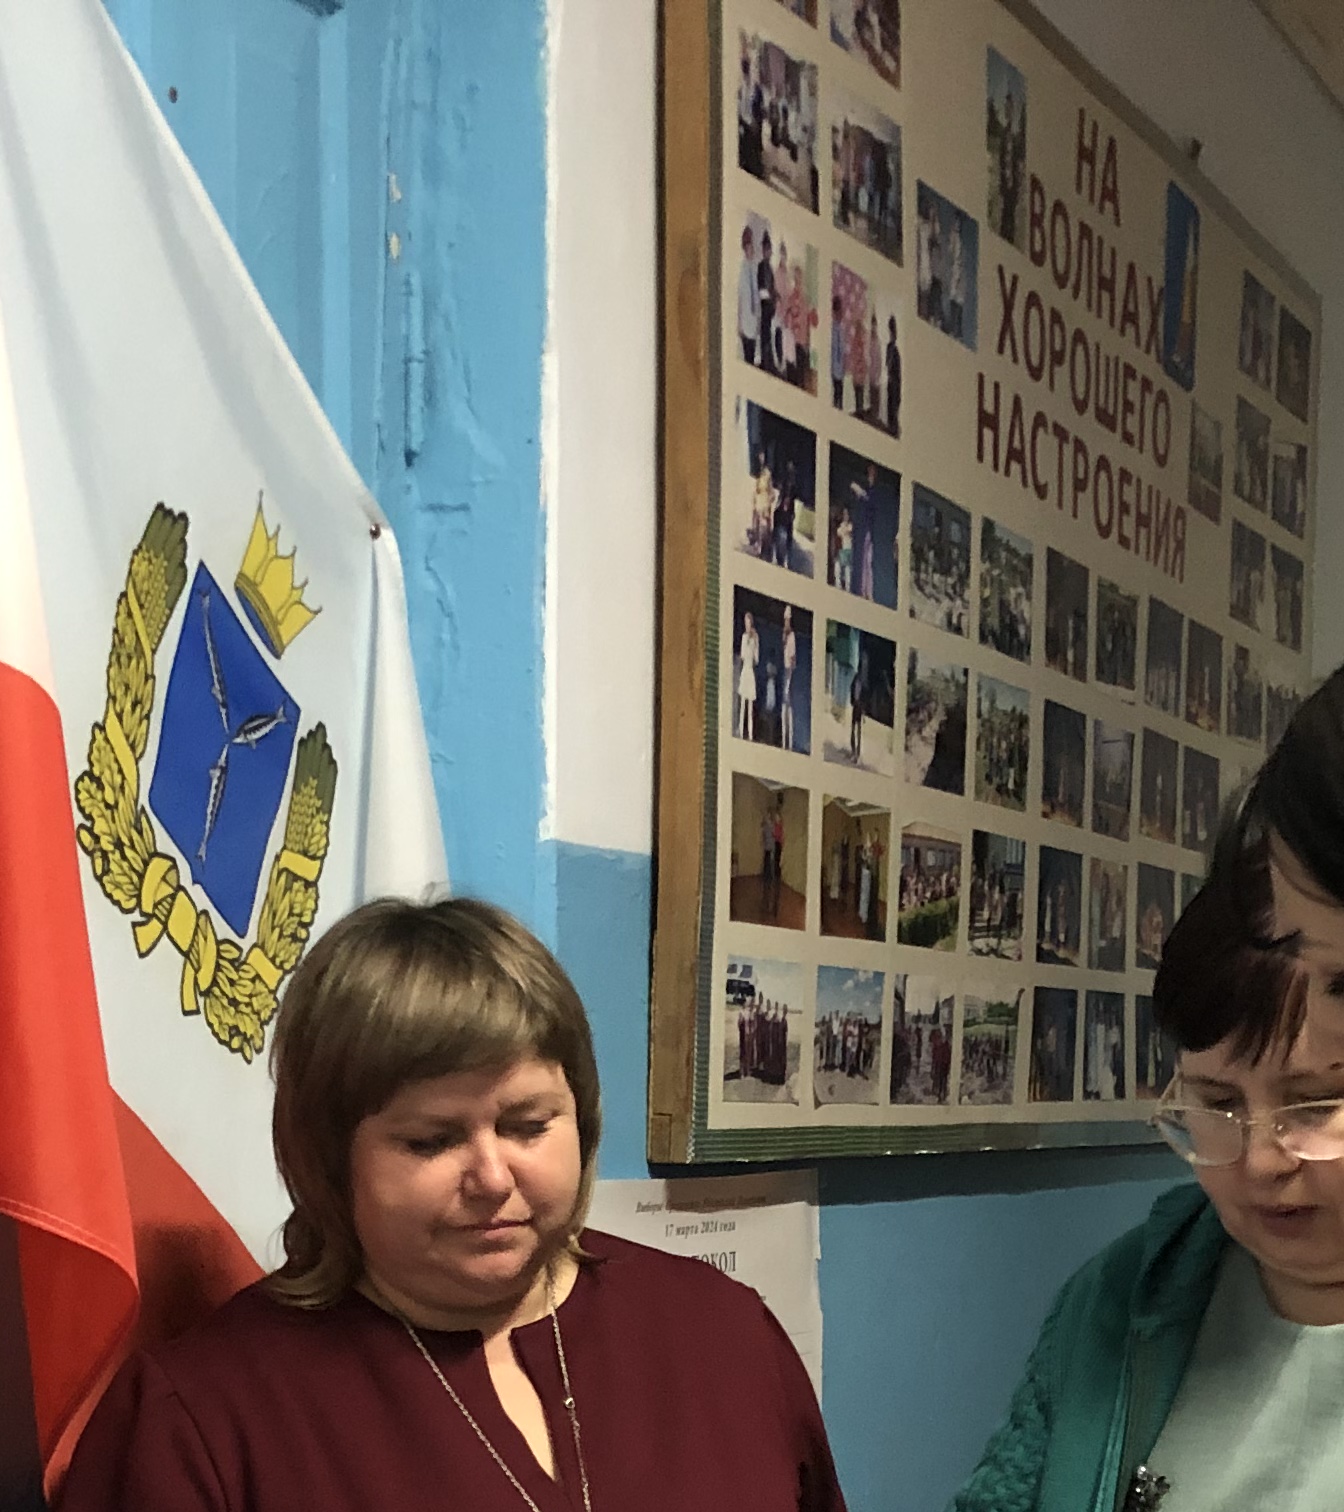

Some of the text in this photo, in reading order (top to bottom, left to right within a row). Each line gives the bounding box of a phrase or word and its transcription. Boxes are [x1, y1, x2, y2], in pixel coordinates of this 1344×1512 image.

[1075, 107, 1121, 228] НА
[1029, 173, 1164, 364] ВОЛНАХ
[997, 264, 1172, 468] ХОРОШЕГО
[976, 372, 1188, 584] НАСТРОЕНИЯ
[665, 1220, 736, 1239] 17 марта 2024 года
